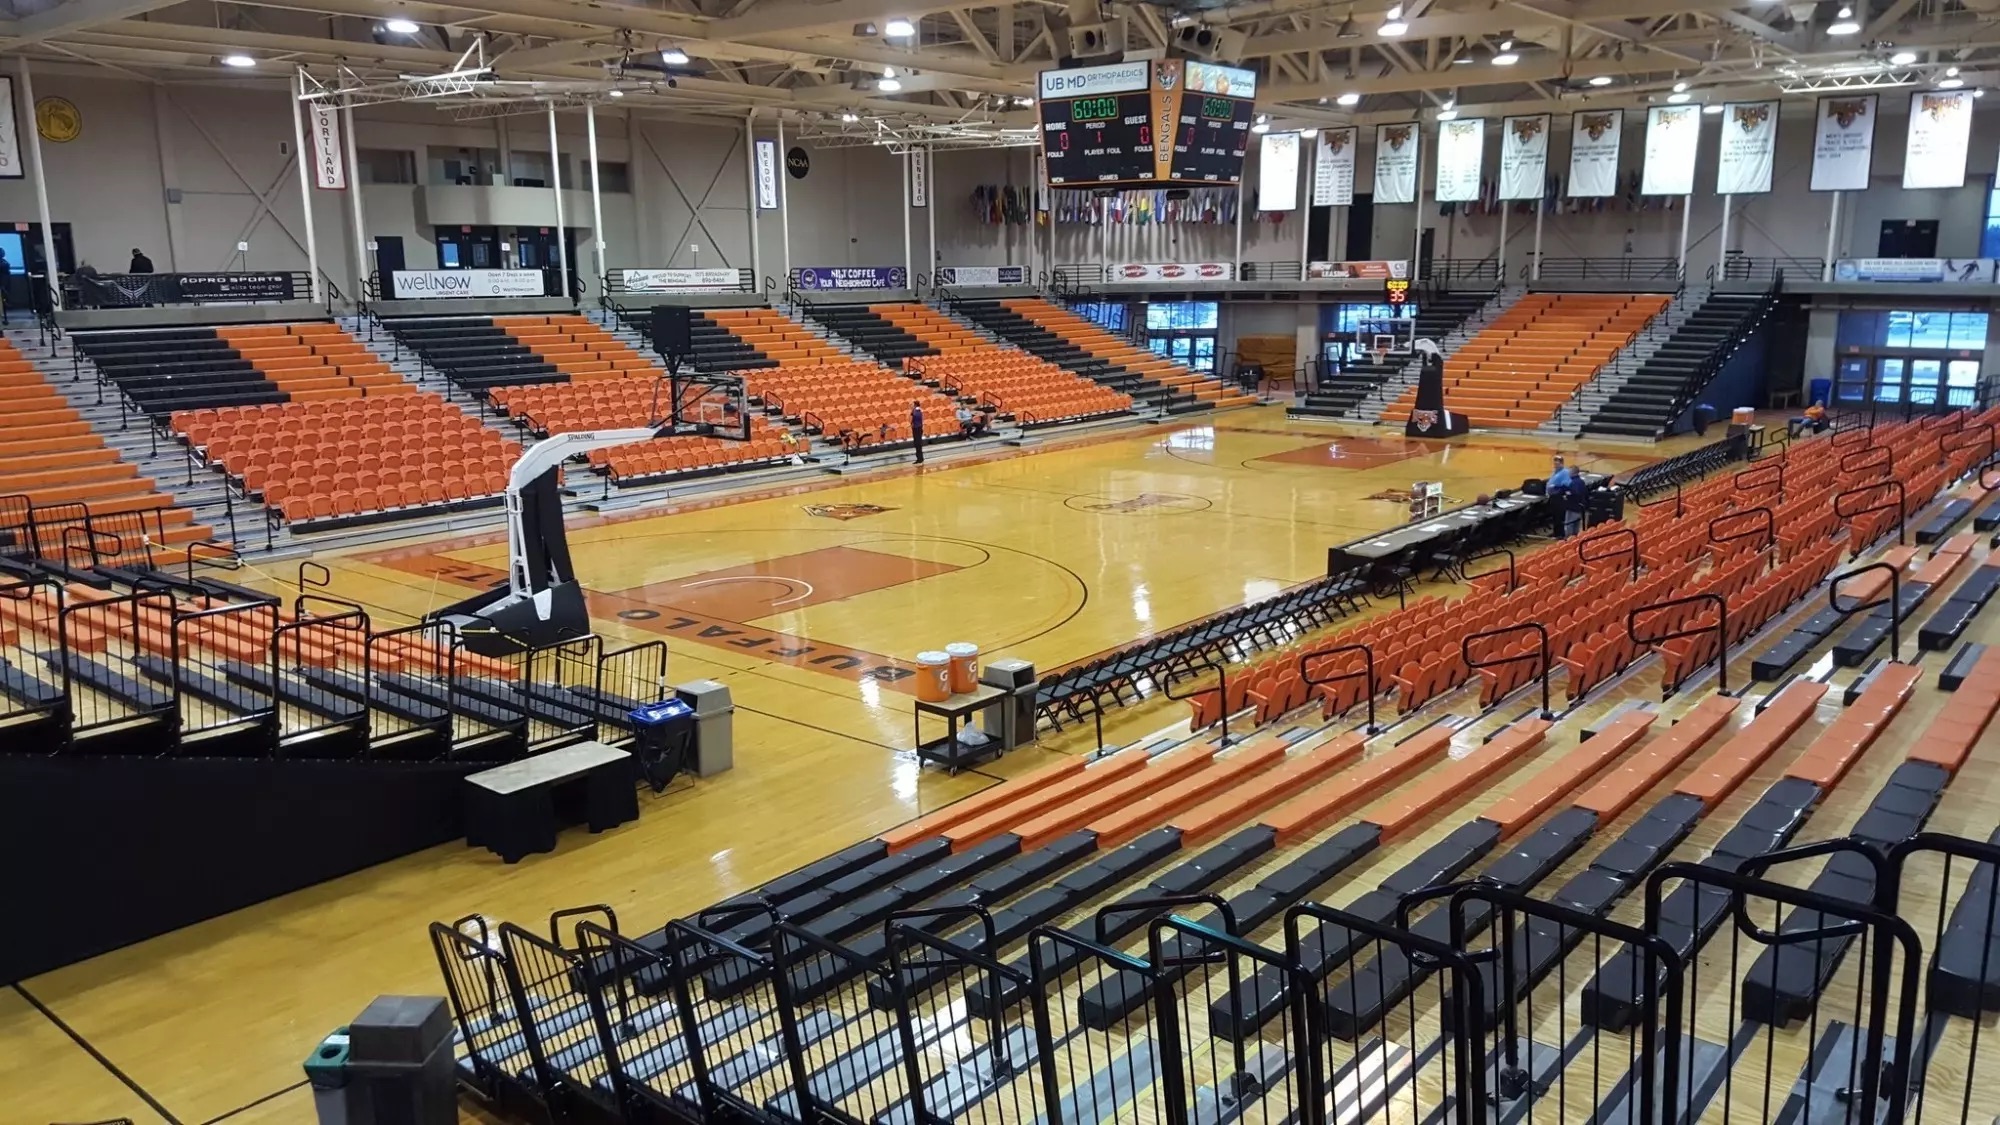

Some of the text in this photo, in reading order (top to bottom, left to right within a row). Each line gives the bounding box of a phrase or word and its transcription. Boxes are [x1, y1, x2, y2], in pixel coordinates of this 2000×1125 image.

[1046, 77, 1064, 91] UB
[1067, 75, 1086, 89] MD
[1087, 69, 1144, 81] ORTHOPAEDICS
[1074, 98, 1116, 119] 60:00
[1124, 115, 1147, 125] GUEST
[1045, 122, 1067, 131] HOME
[1160, 95, 1172, 162] BENGALS
[1060, 132, 1069, 150] 0
[1140, 126, 1150, 145] 0
[1084, 148, 1104, 156] PLAYER
[1134, 145, 1153, 153] FOULS
[787, 156, 809, 169] NCAA
[847, 268, 876, 279] COFFEE
[1321, 270, 1350, 278] LEASING
[835, 278, 872, 288] NEIGHBORHOOD
[1390, 289, 1405, 302] 35
[567, 433, 595, 441] SPALDING
[969, 661, 977, 673] G
[940, 670, 948, 682] G
